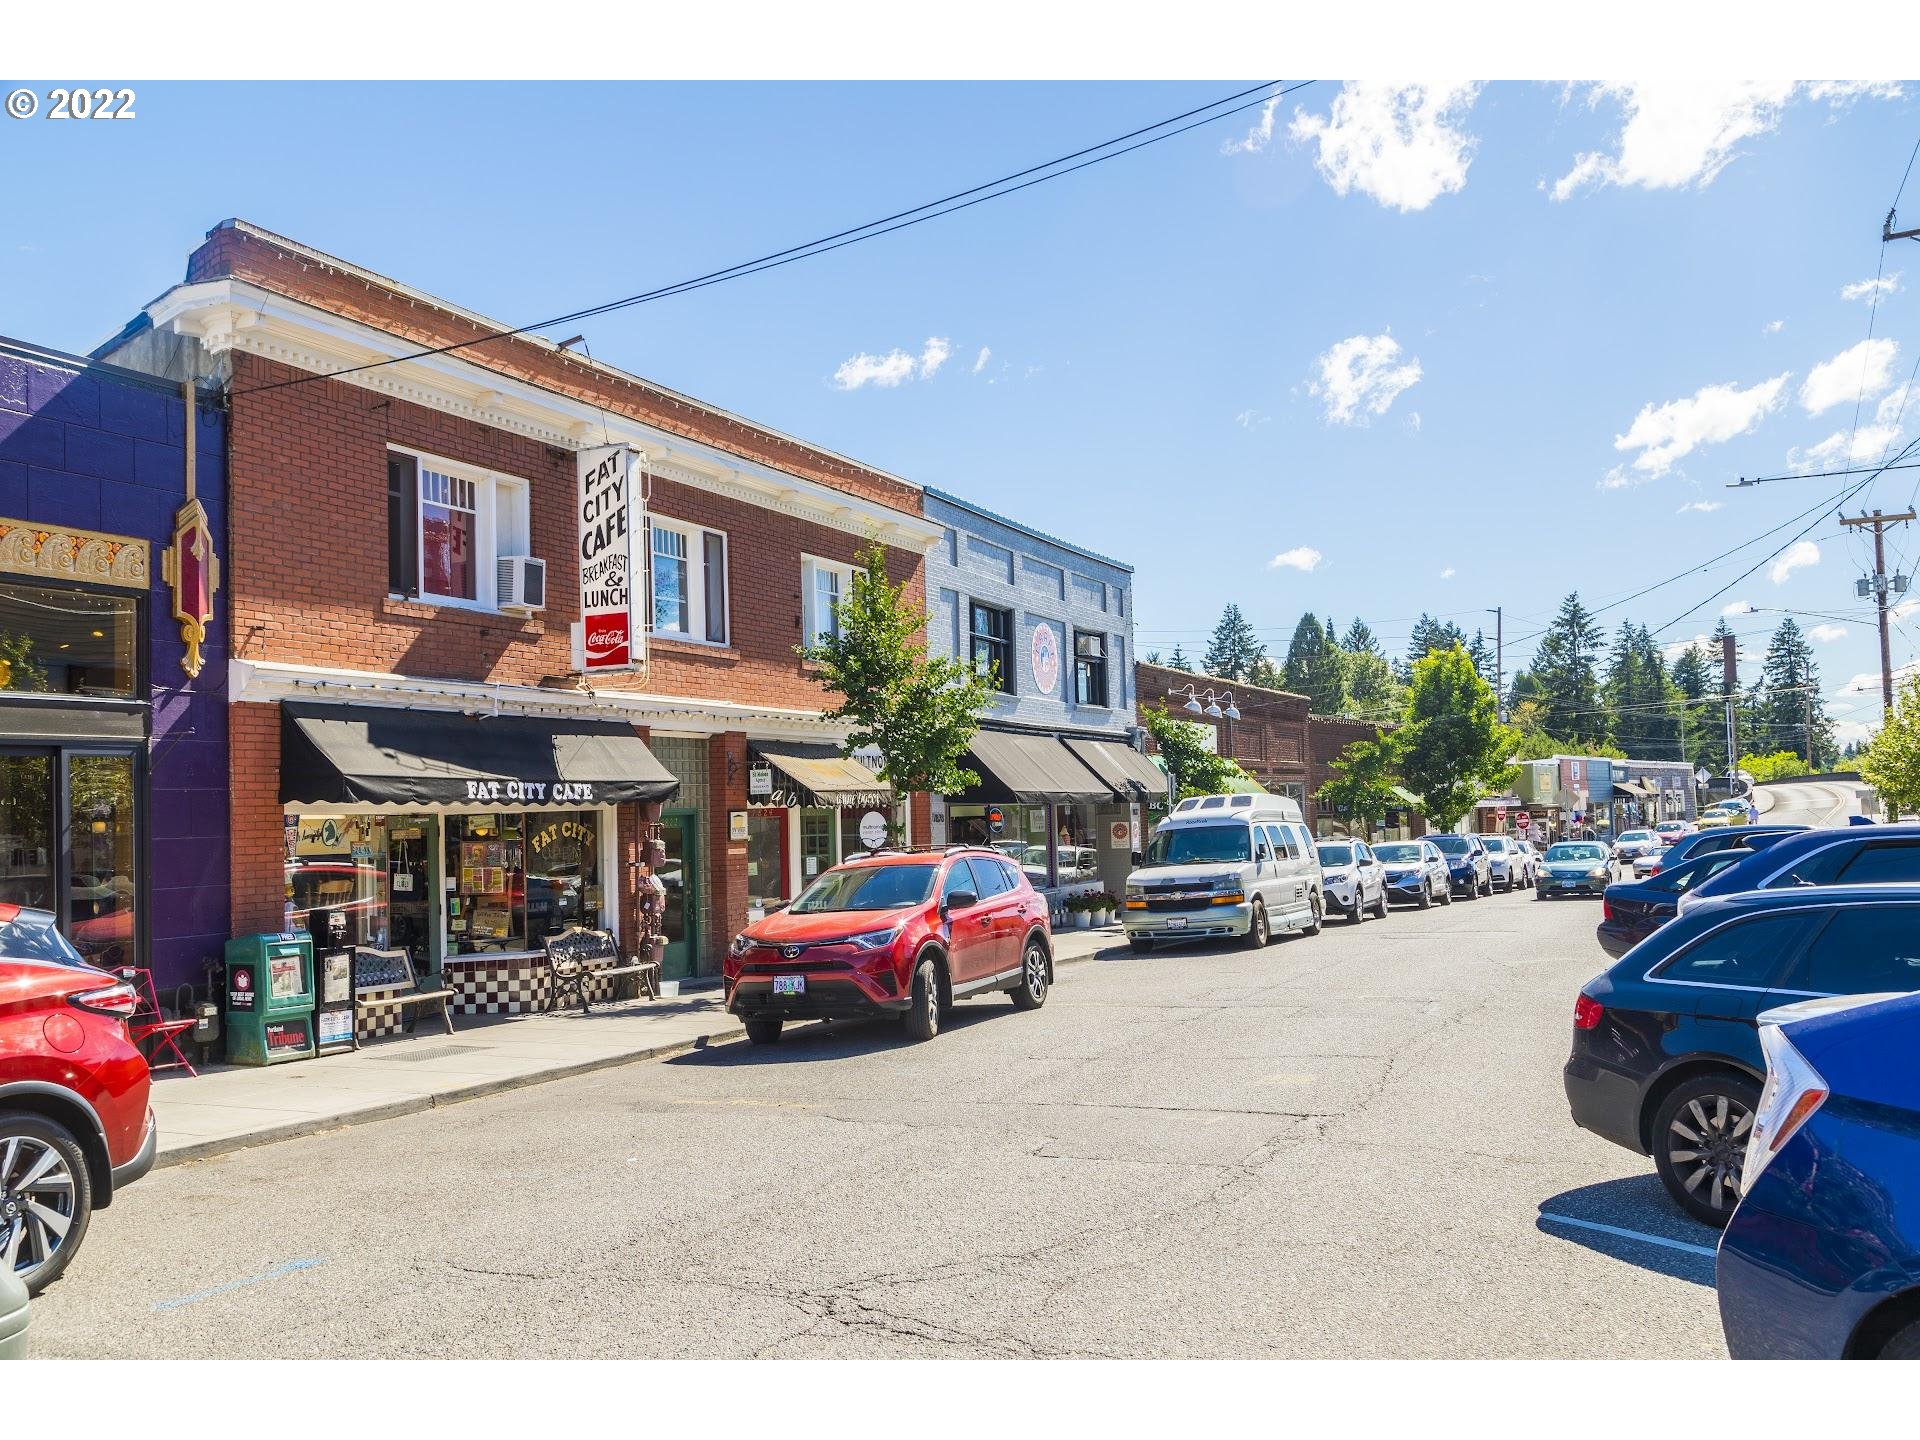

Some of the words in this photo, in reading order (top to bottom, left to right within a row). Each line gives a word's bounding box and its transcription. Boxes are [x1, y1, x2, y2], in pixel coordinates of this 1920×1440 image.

[585, 449, 620, 495] FAT
[583, 474, 625, 523] CITY
[582, 504, 627, 560] CAFE
[582, 554, 628, 585] BREAKFAST
[604, 571, 624, 587] &
[584, 587, 629, 608] LUNCH
[466, 781, 500, 799] FAT
[507, 782, 547, 800] CITY
[552, 783, 593, 800] CAFE
[531, 823, 558, 854] FAT
[561, 821, 596, 847] CITY
[268, 1031, 305, 1046] Tribune
